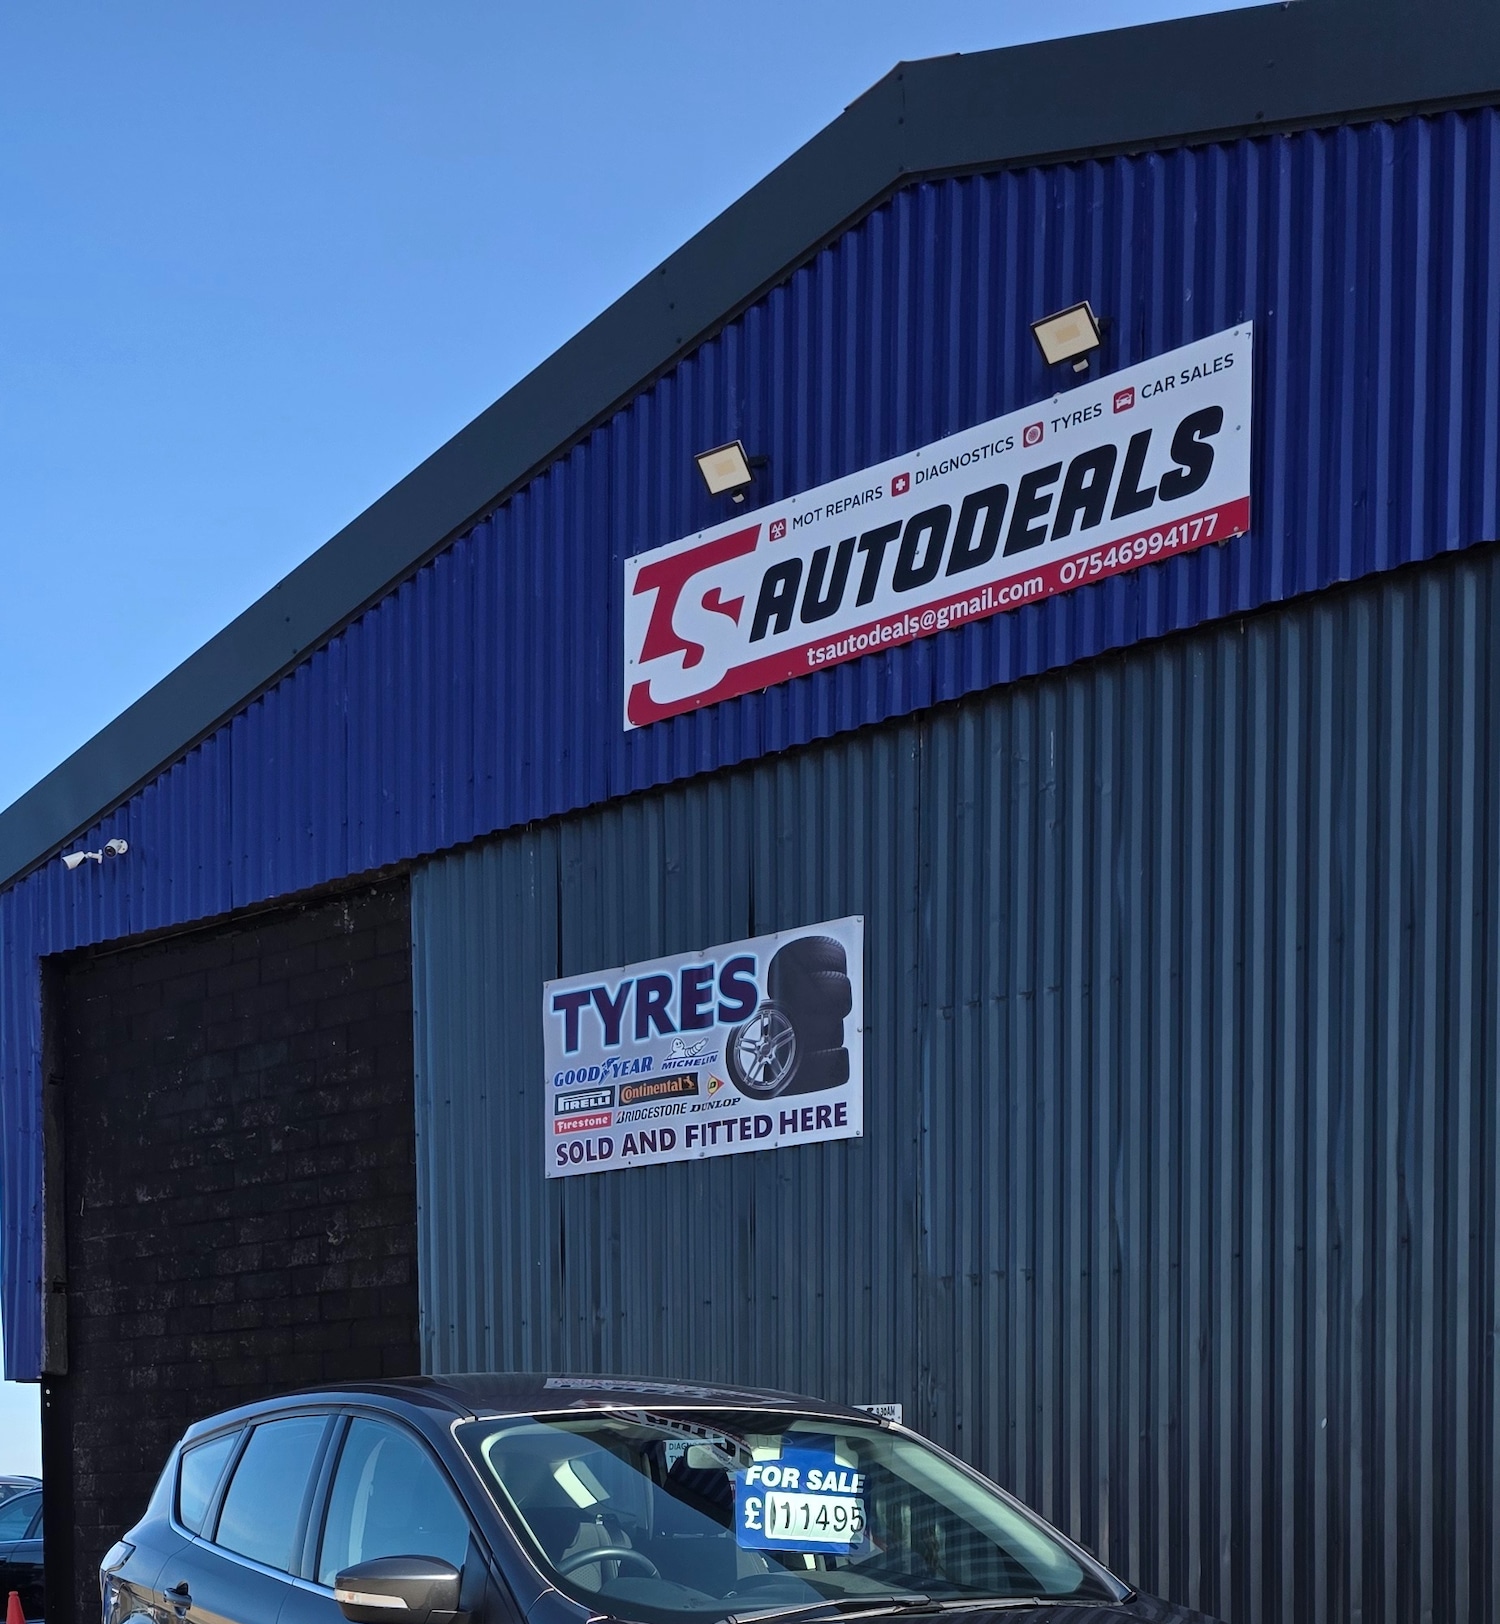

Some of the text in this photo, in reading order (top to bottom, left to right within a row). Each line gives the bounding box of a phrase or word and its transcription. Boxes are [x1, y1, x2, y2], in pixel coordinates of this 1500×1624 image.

[1141, 353, 1234, 399] CAR SALES
[1051, 403, 1103, 433] TYRES
[915, 434, 1014, 485] DIAGNOSTICS
[792, 486, 883, 530] MOT REPAIRS
[628, 405, 1224, 725] TS AUTODEALS
[806, 512, 1219, 666] tsautodeals@gmail.com 07546994177
[552, 955, 758, 1054] TYRES
[661, 1054, 718, 1071] MICHELIN
[557, 1090, 612, 1112] PIRELLI
[620, 1077, 683, 1104] Continental
[689, 1097, 742, 1113] DUNLOP
[556, 1115, 609, 1133] Firestone
[616, 1102, 688, 1125] BRIDGESTONE
[556, 1102, 848, 1167] SOLD AND FITTED HERE
[745, 1465, 801, 1489] FOR
[806, 1469, 865, 1493] SALE
